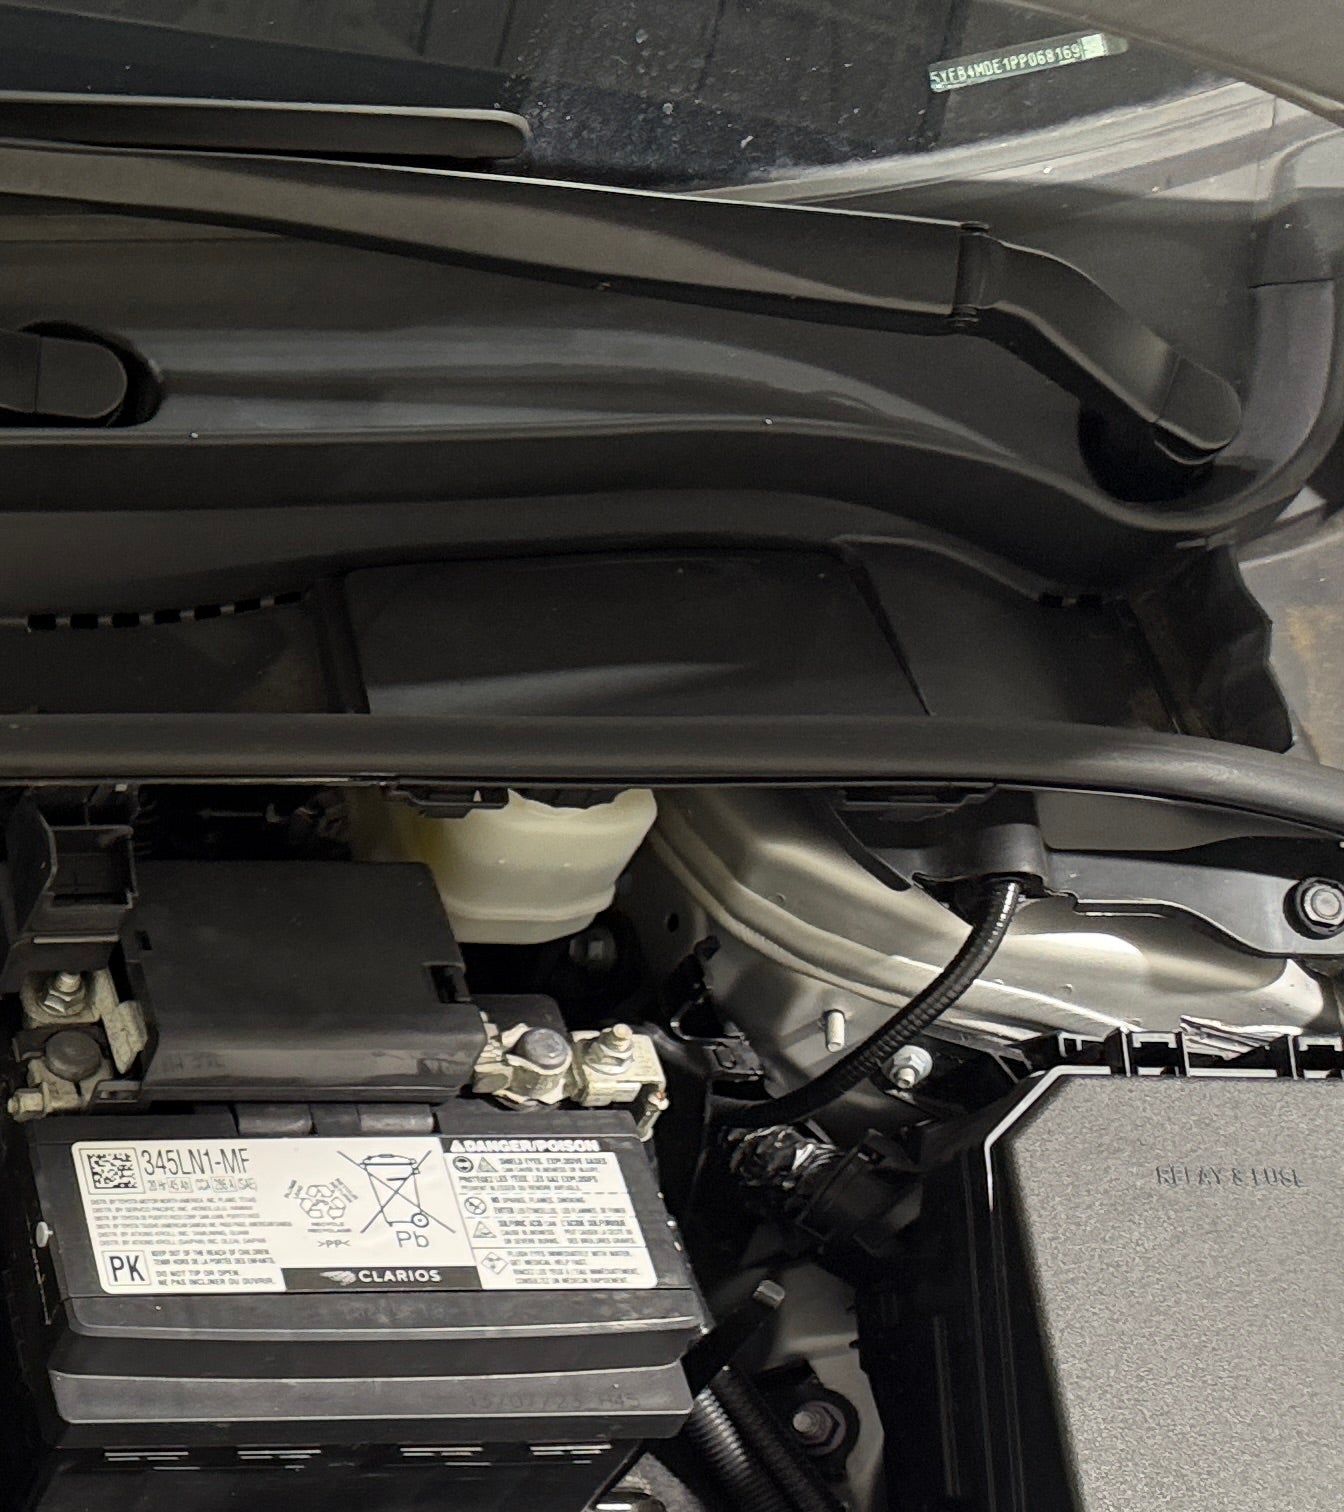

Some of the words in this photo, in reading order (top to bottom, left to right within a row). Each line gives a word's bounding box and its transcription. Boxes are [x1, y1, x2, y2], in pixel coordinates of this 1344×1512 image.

[141, 1148, 250, 1175] 345LN1-MF
[396, 1230, 429, 1248] Pb
[109, 1255, 145, 1282] PK
[358, 1269, 442, 1282] CLARIOS
